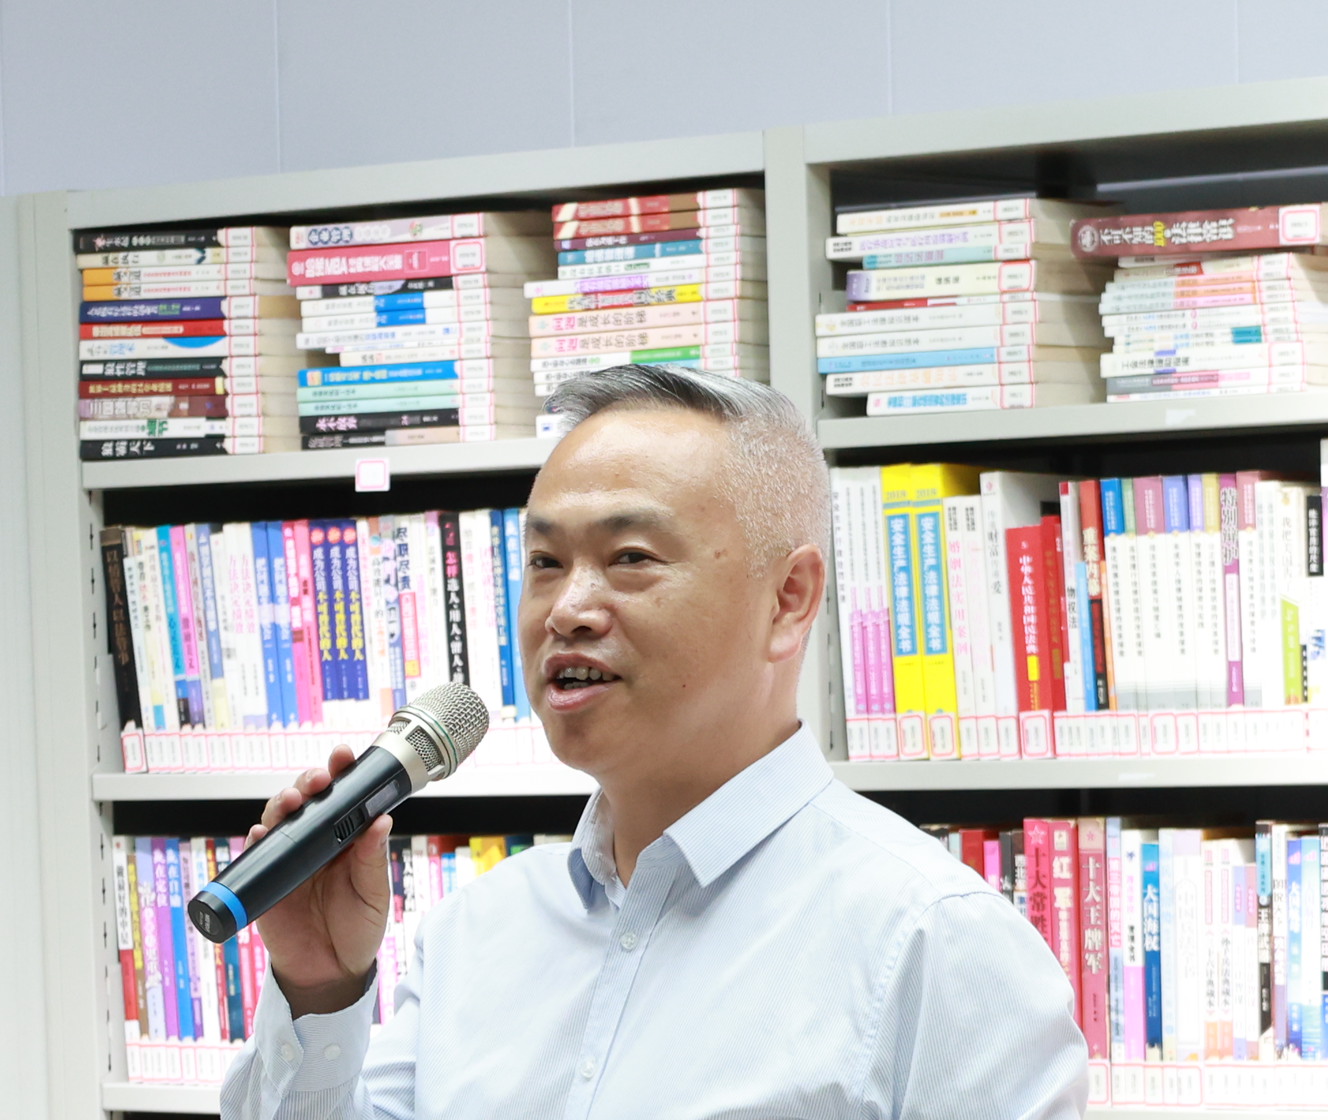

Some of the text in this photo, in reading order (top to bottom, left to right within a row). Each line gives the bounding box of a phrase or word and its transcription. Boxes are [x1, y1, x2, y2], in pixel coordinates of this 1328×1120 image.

[313, 547, 333, 661] 成为公司不可替代的人
[330, 546, 349, 660] 成为公司不可替代的人
[345, 546, 364, 661] 成为公司不可替代的人
[395, 526, 412, 591] 尽职尽责
[890, 517, 914, 653] 安全生产法律法规全书
[920, 515, 943, 652] 安全生产法律法规全书
[1018, 554, 1041, 654] 中华人民共和国民法典
[1082, 857, 1105, 975] 十大王牌军
[1143, 884, 1159, 951] 大国海权
